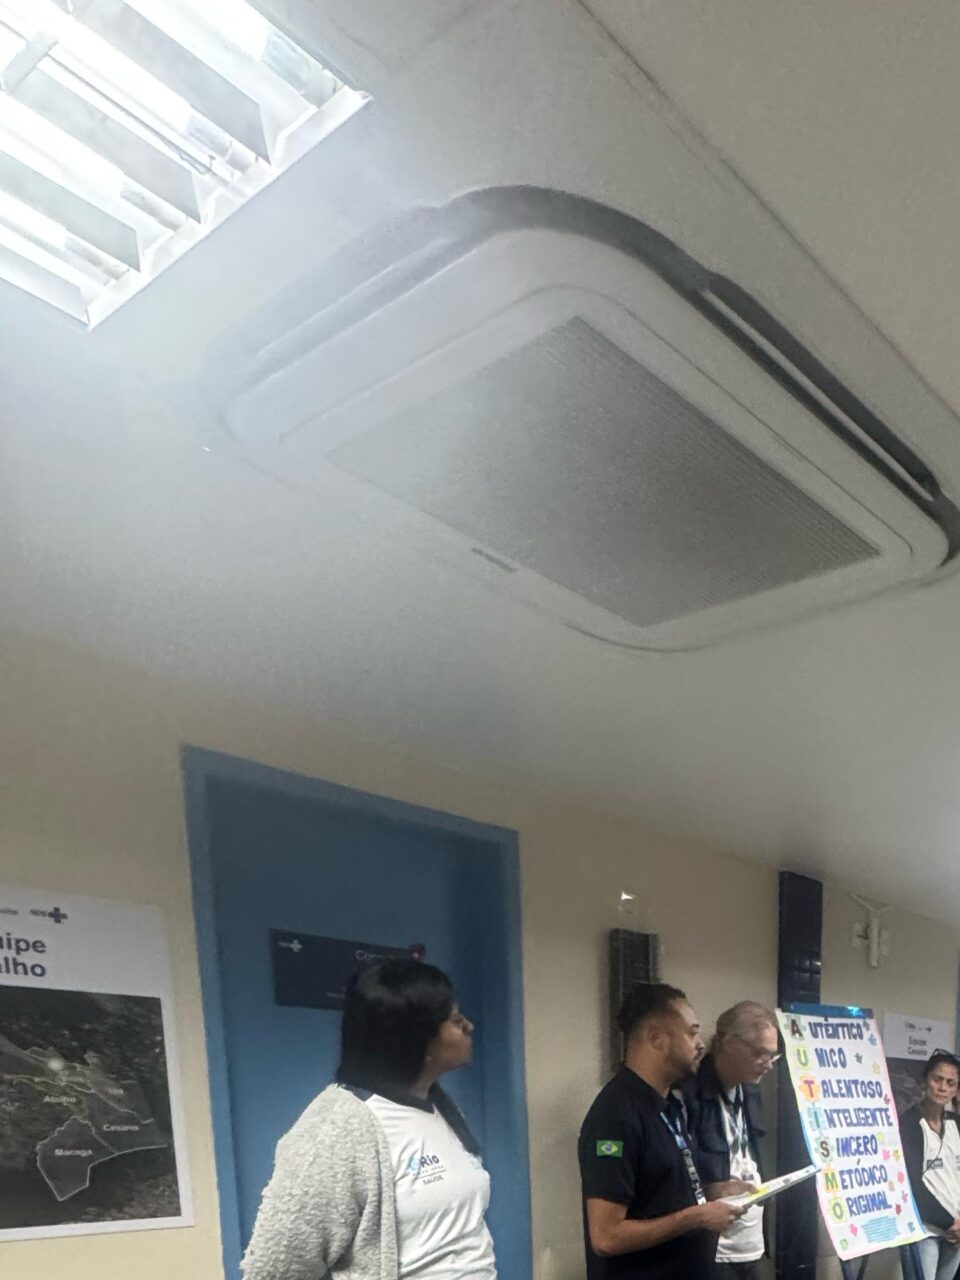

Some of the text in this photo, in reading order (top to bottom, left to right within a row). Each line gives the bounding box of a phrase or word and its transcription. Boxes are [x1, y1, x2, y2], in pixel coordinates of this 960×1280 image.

[0, 932, 46, 956] ipe
[0, 956, 46, 977] lho
[420, 1155, 440, 1168] Rio
